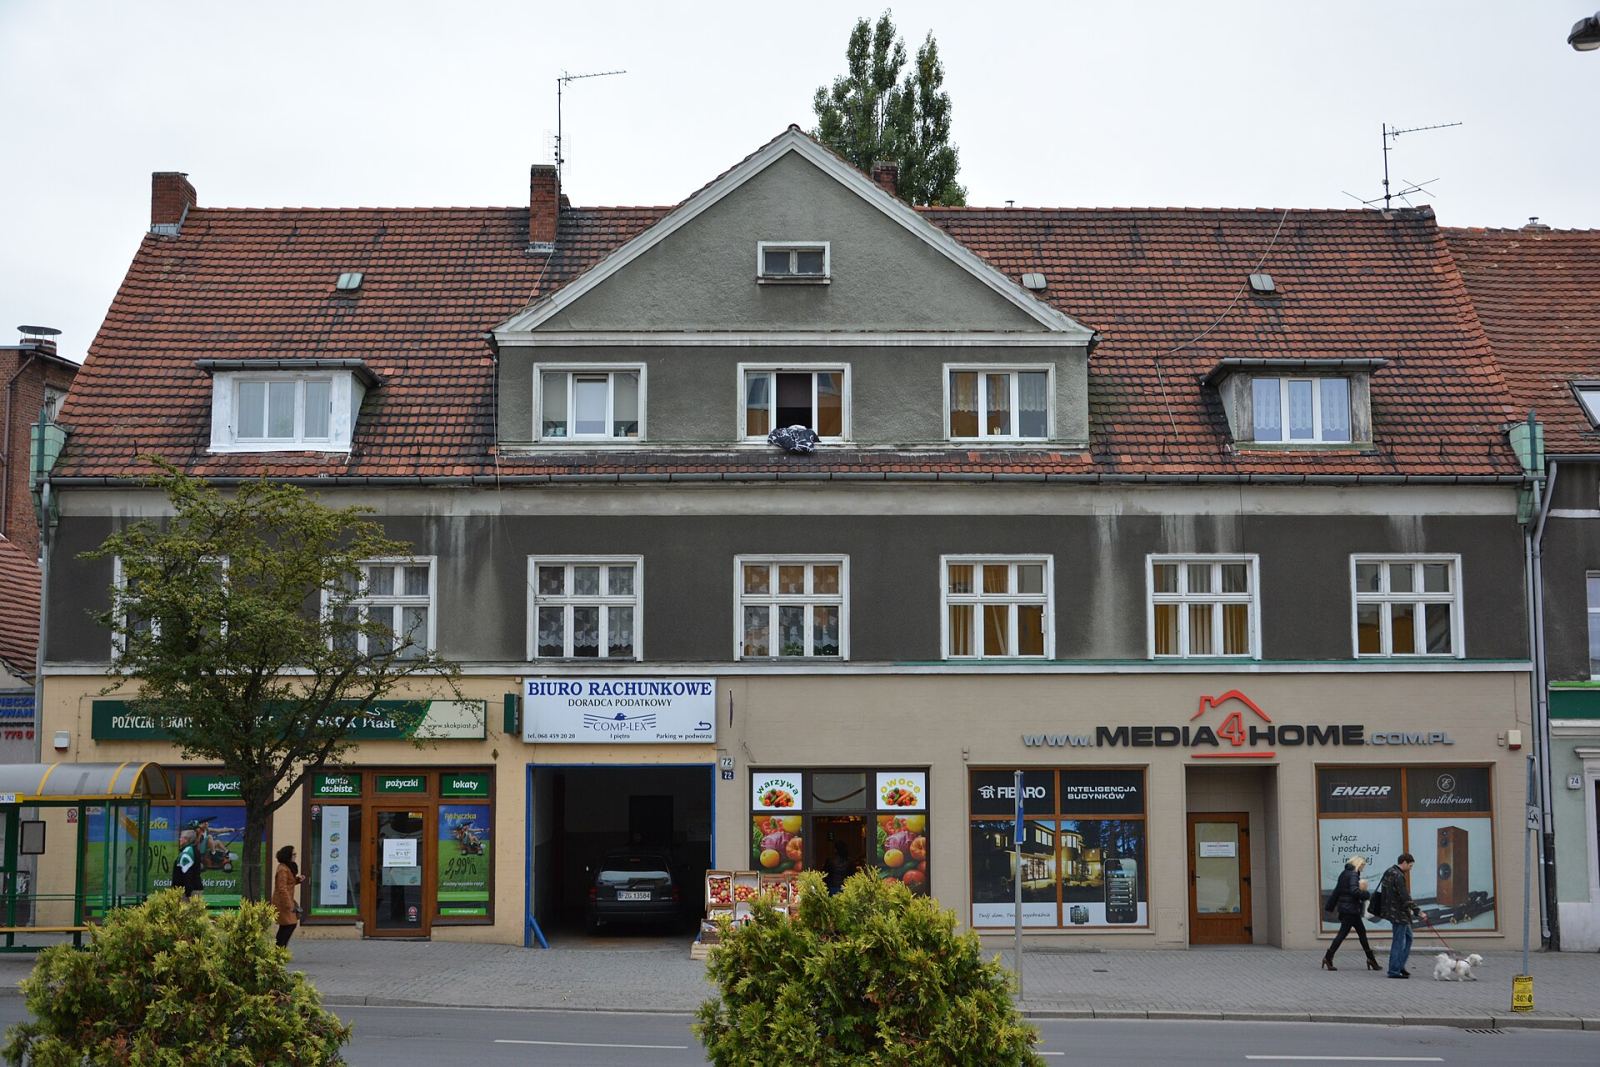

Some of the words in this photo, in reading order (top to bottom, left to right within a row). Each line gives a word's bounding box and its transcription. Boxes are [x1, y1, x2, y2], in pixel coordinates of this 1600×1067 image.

[528, 682, 583, 696] BIURO
[589, 682, 712, 696] RACHUNKOWE
[568, 699, 613, 707] DORADCA
[615, 699, 672, 707] PODATKOWY
[593, 722, 647, 731] COMP-LEX
[722, 757, 732, 766] 72
[385, 778, 418, 789] pożyczki
[453, 780, 478, 790] lokaty
[1570, 777, 1580, 785] 74
[757, 779, 798, 795] warzywa
[1331, 786, 1392, 796] ENERR
[1420, 795, 1473, 807] equilibrium
[1331, 833, 1358, 843] włącz
[1338, 843, 1381, 854] posłuchaj
